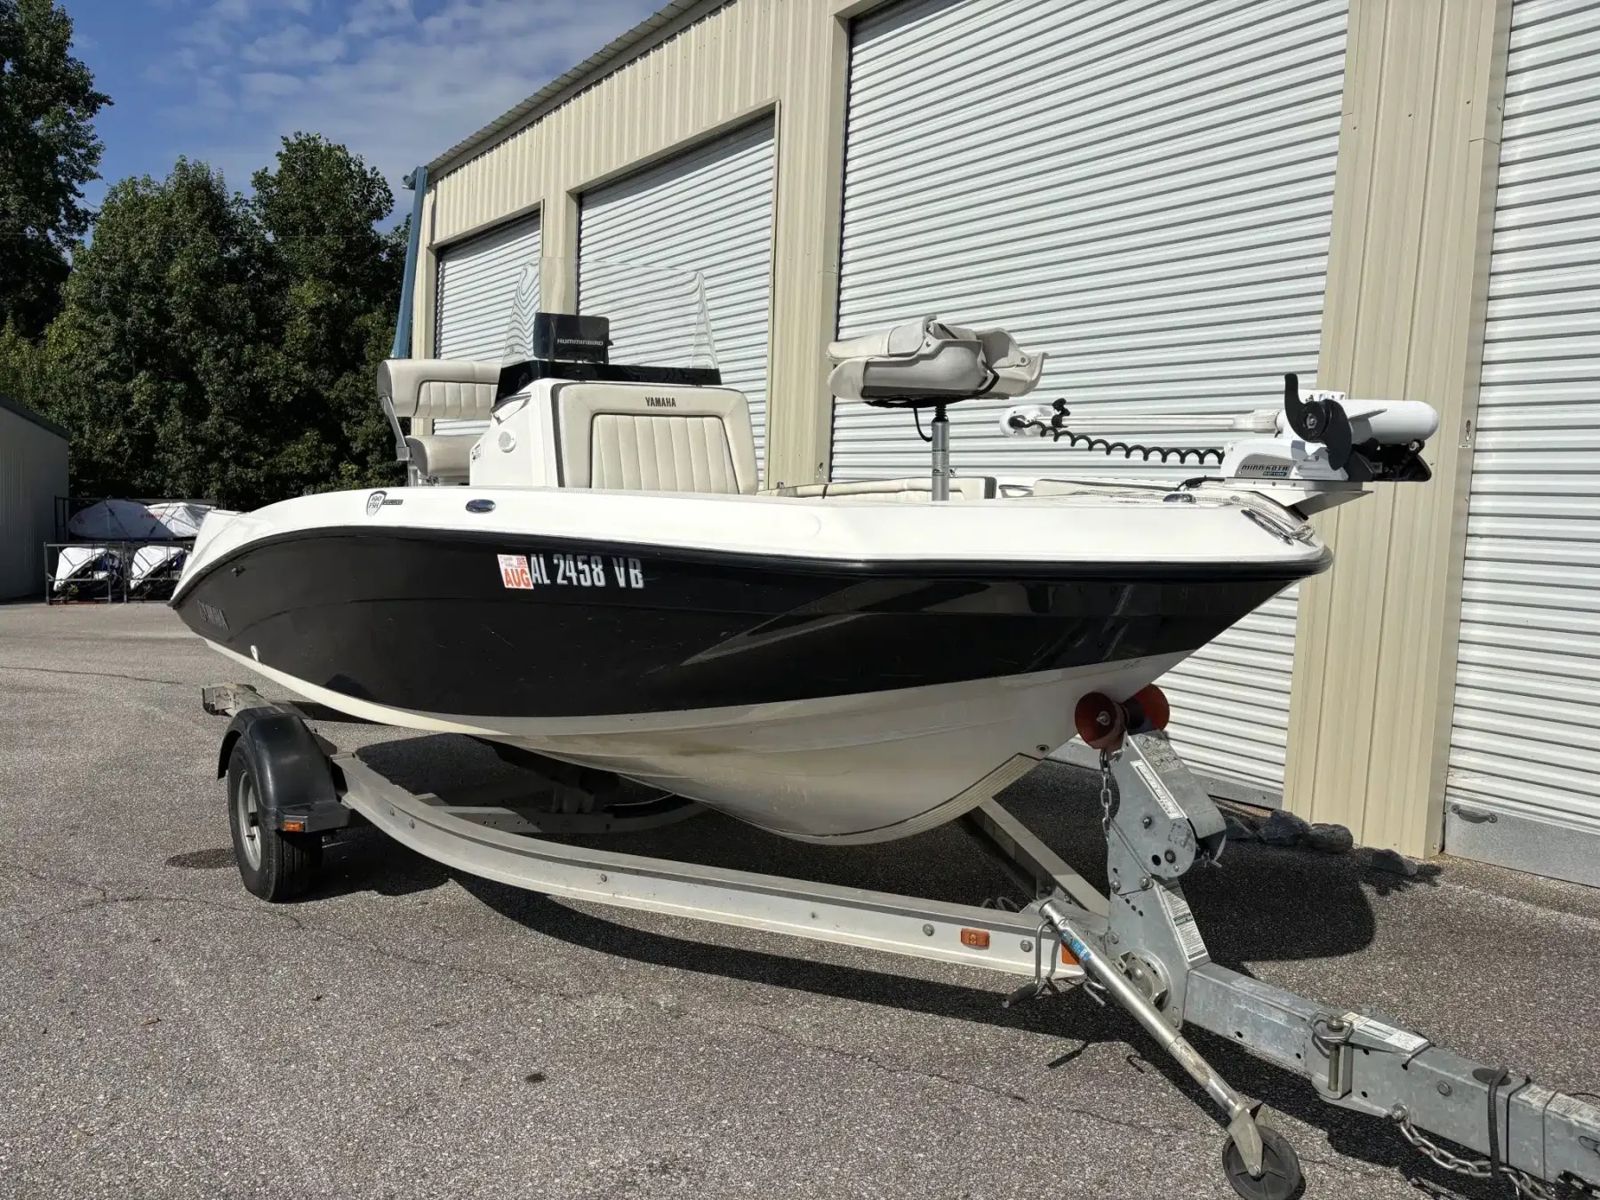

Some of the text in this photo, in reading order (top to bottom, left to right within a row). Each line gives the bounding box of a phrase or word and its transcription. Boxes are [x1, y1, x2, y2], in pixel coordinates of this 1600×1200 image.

[645, 397, 677, 407] YAMAHA
[504, 568, 532, 587] AUG
[530, 554, 551, 584] AL
[553, 554, 606, 587] 2458
